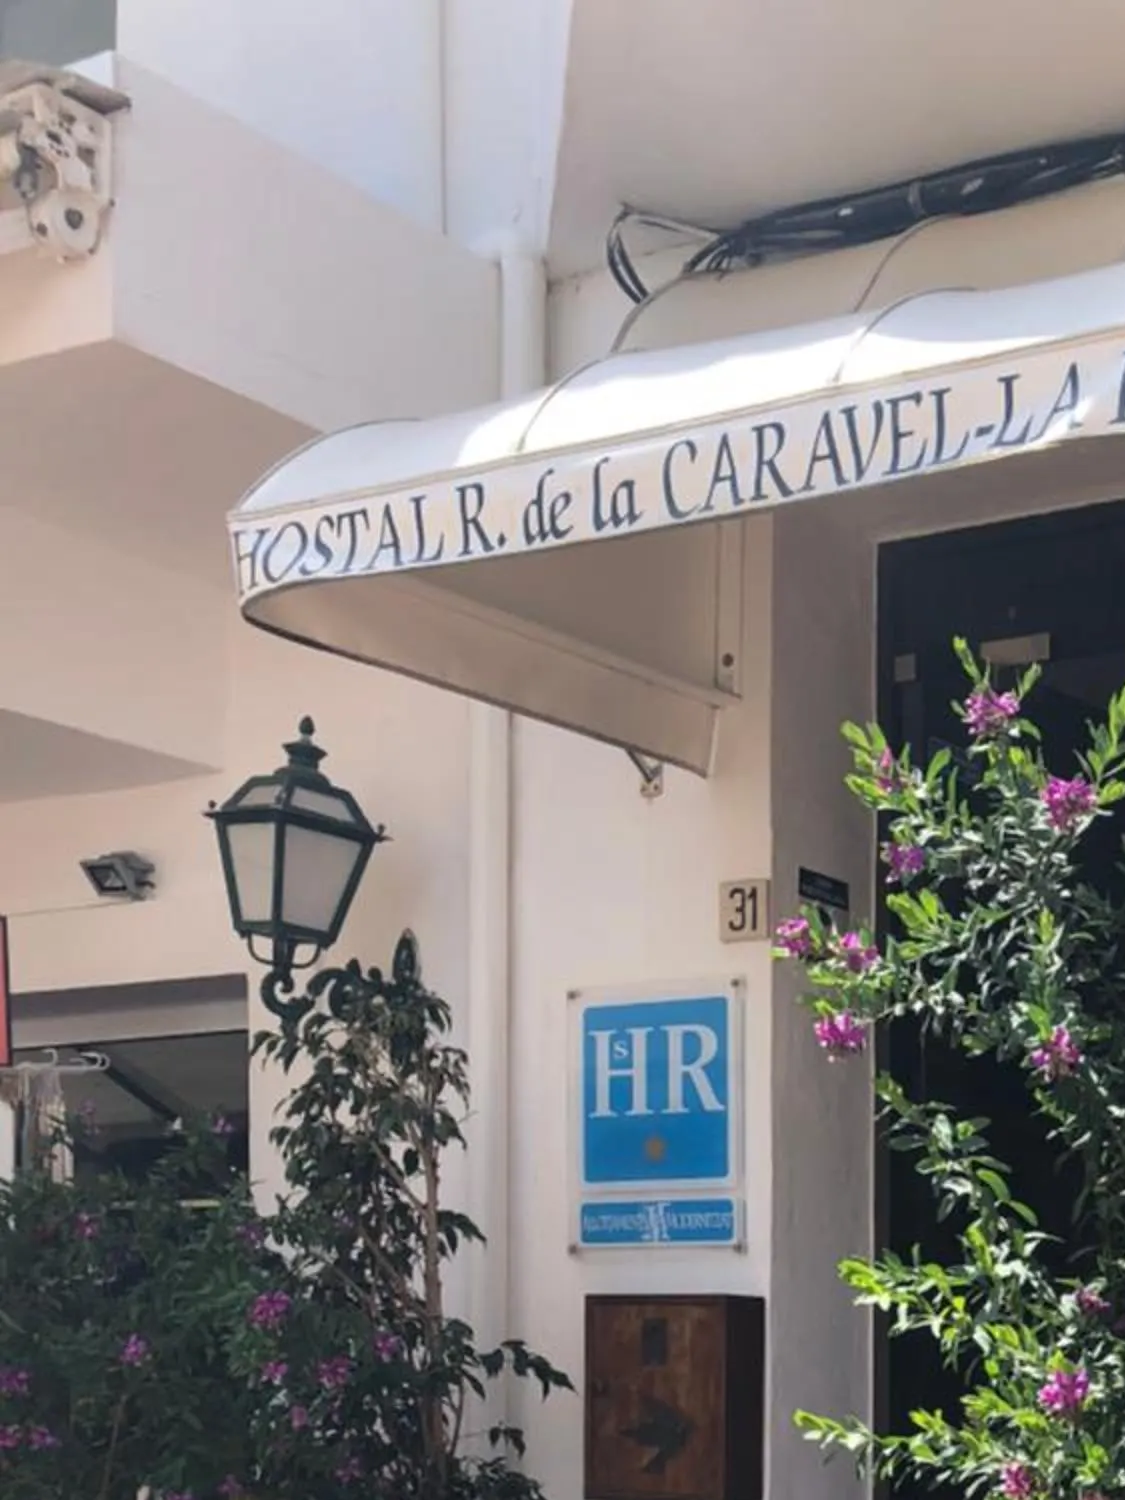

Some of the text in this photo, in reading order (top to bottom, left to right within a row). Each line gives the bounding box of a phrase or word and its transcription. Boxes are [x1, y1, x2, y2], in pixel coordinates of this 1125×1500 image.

[233, 494, 445, 592] HOSTAL
[456, 482, 507, 557] R.
[522, 468, 574, 544] de
[591, 457, 643, 531] la
[662, 361, 1084, 519] CARAVEL-LA
[728, 886, 758, 932] 31
